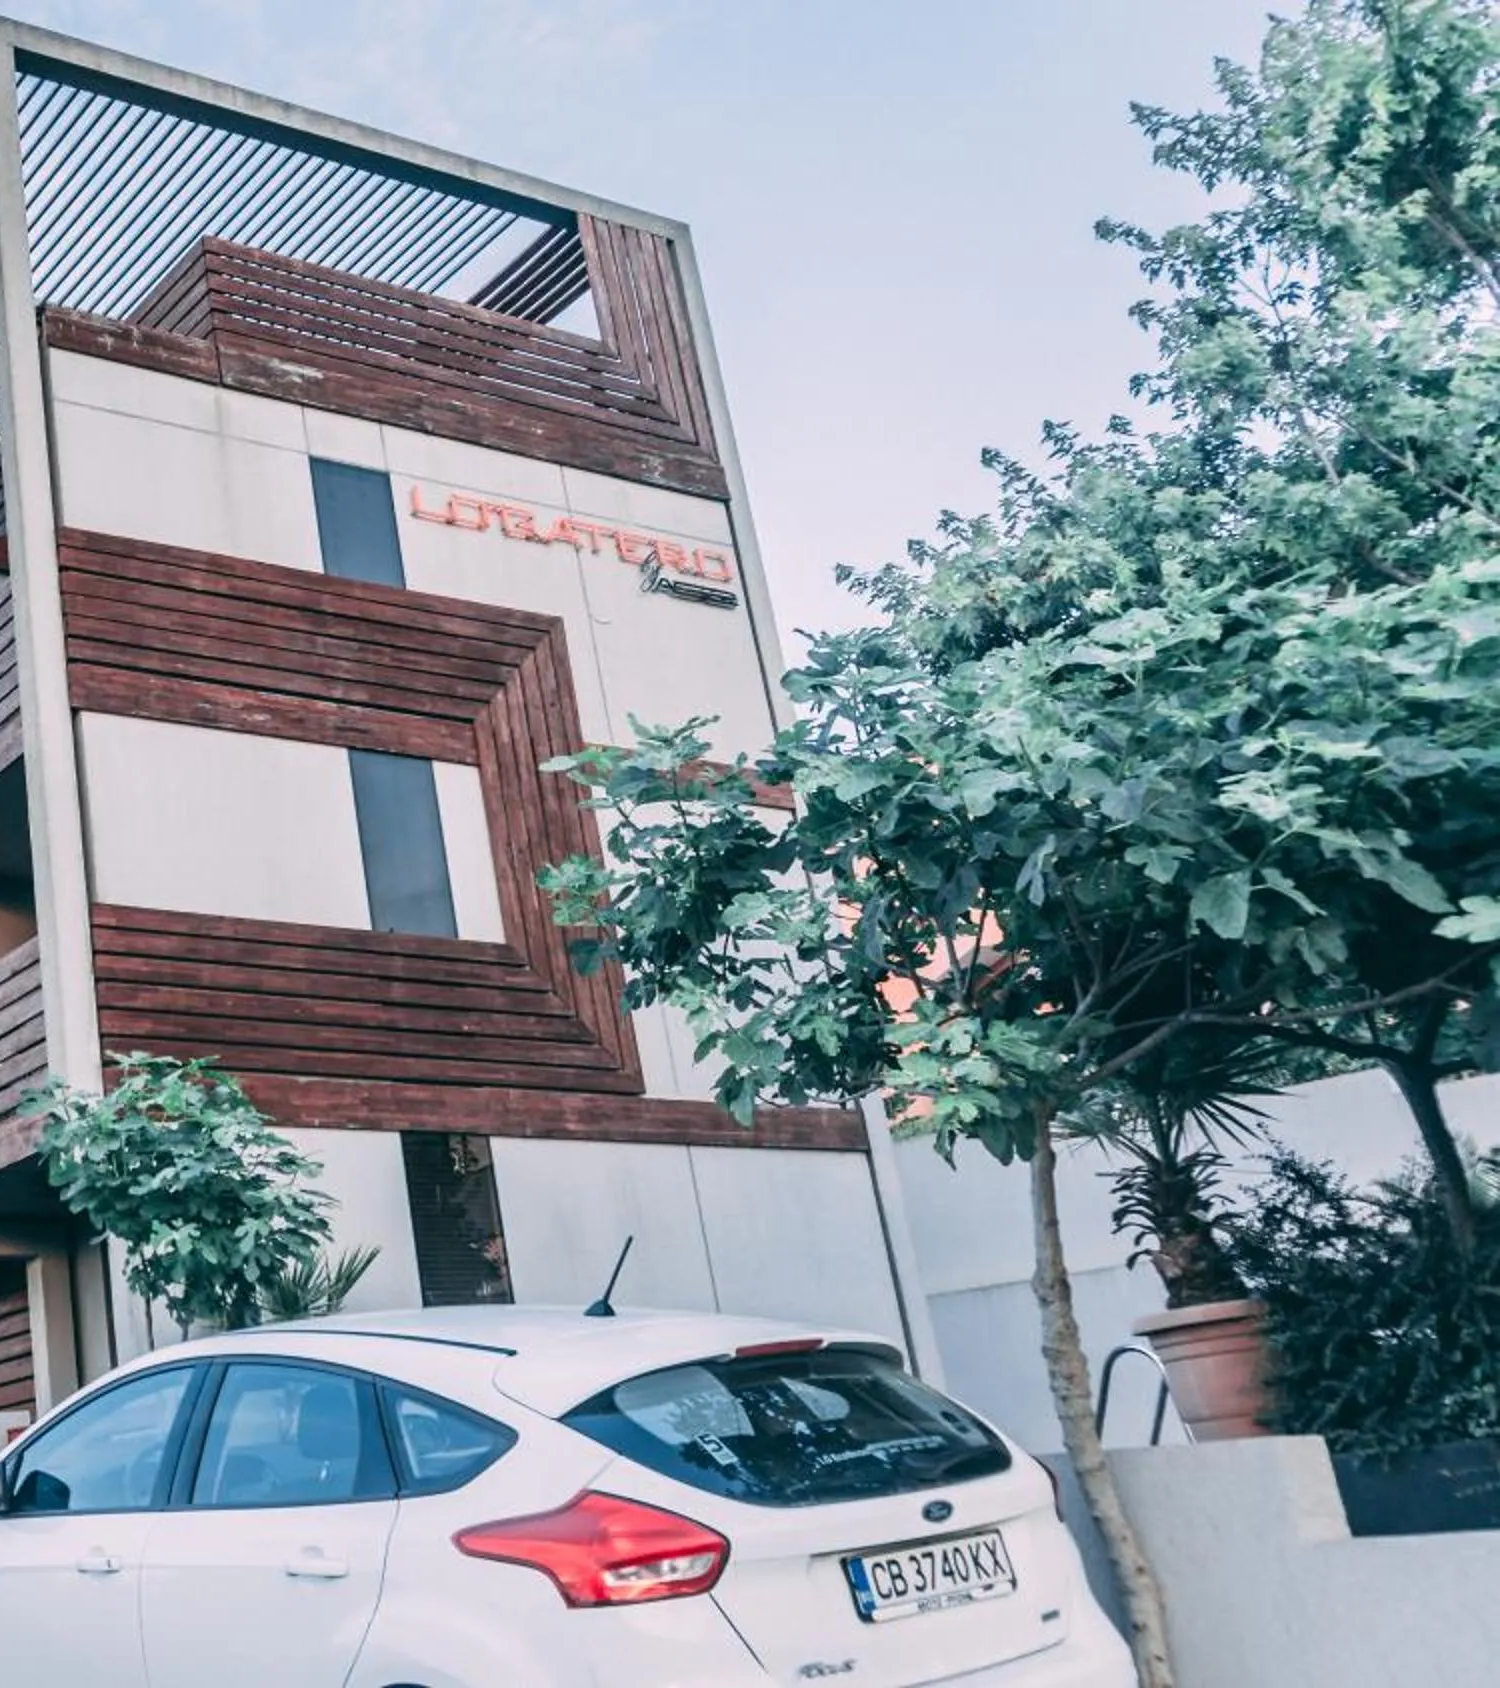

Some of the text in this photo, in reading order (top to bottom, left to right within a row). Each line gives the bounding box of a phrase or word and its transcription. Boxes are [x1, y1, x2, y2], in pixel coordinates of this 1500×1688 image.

[871, 1537, 1006, 1600] CB 3740 KX
